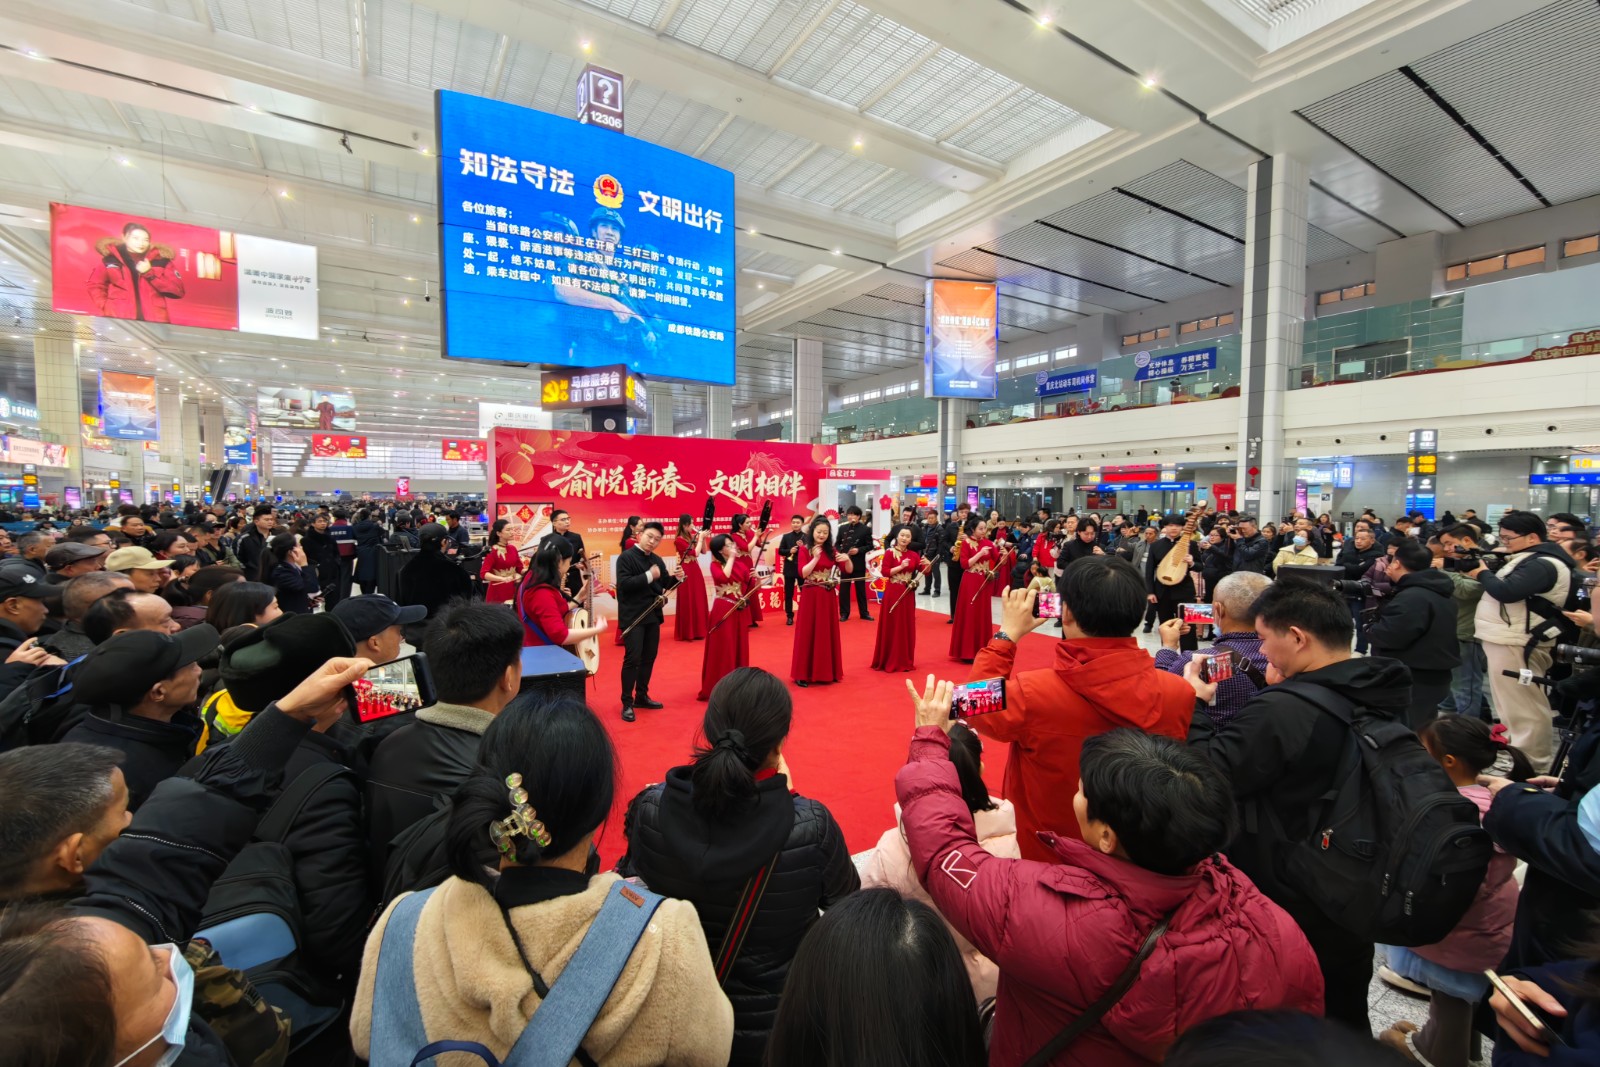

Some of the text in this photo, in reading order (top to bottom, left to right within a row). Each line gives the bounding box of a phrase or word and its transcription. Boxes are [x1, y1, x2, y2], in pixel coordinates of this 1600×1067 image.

[590, 110, 622, 128] 12306
[459, 148, 723, 234] 知法守法 文明出行
[462, 201, 513, 219] 各位旅客：
[667, 323, 724, 341] 成都铁路公安局
[1148, 358, 1174, 369] 充分休息
[1181, 361, 1209, 372] 万无一失
[706, 468, 806, 508] 文明相伴
[520, 508, 531, 520] 福
